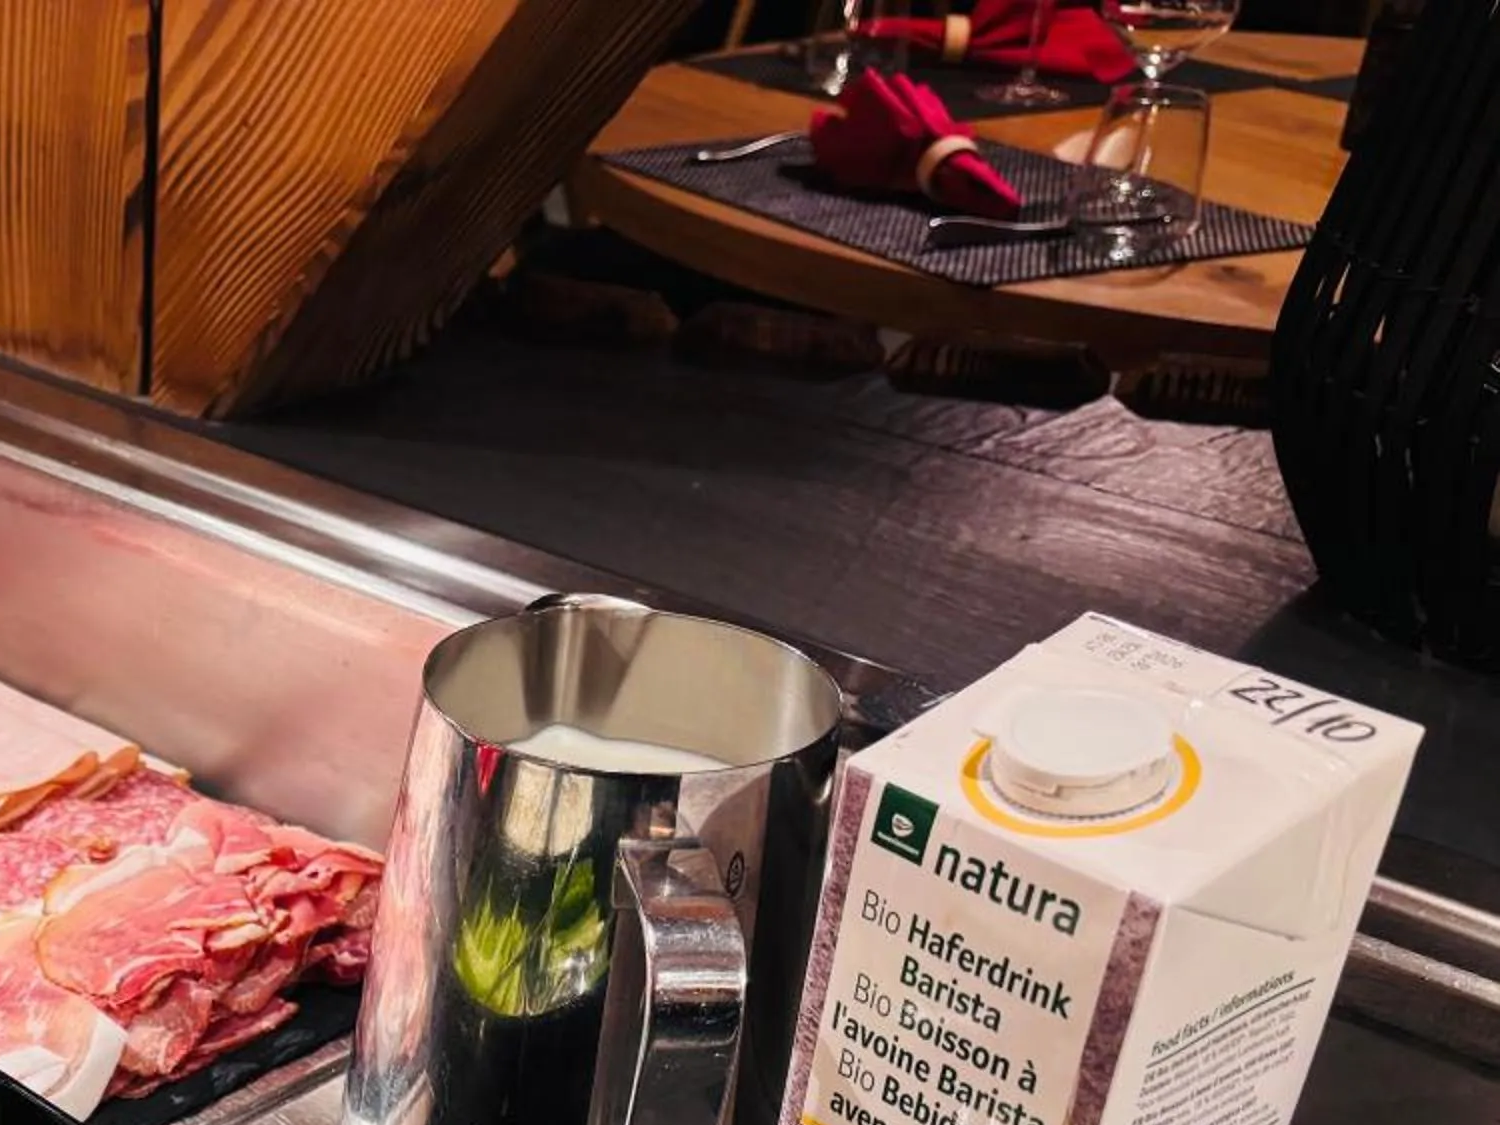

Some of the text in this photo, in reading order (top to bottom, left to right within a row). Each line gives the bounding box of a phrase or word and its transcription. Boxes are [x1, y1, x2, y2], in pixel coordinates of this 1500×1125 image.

[1229, 679, 1377, 742] 22/10
[933, 843, 1082, 936] natura
[861, 888, 1072, 1019] Bio Haferdrink
[899, 954, 1002, 1033] Barista
[832, 1000, 930, 1083] l'avoine
[837, 1047, 875, 1093] Bio
[853, 972, 1037, 1094] Bio Boisson à
